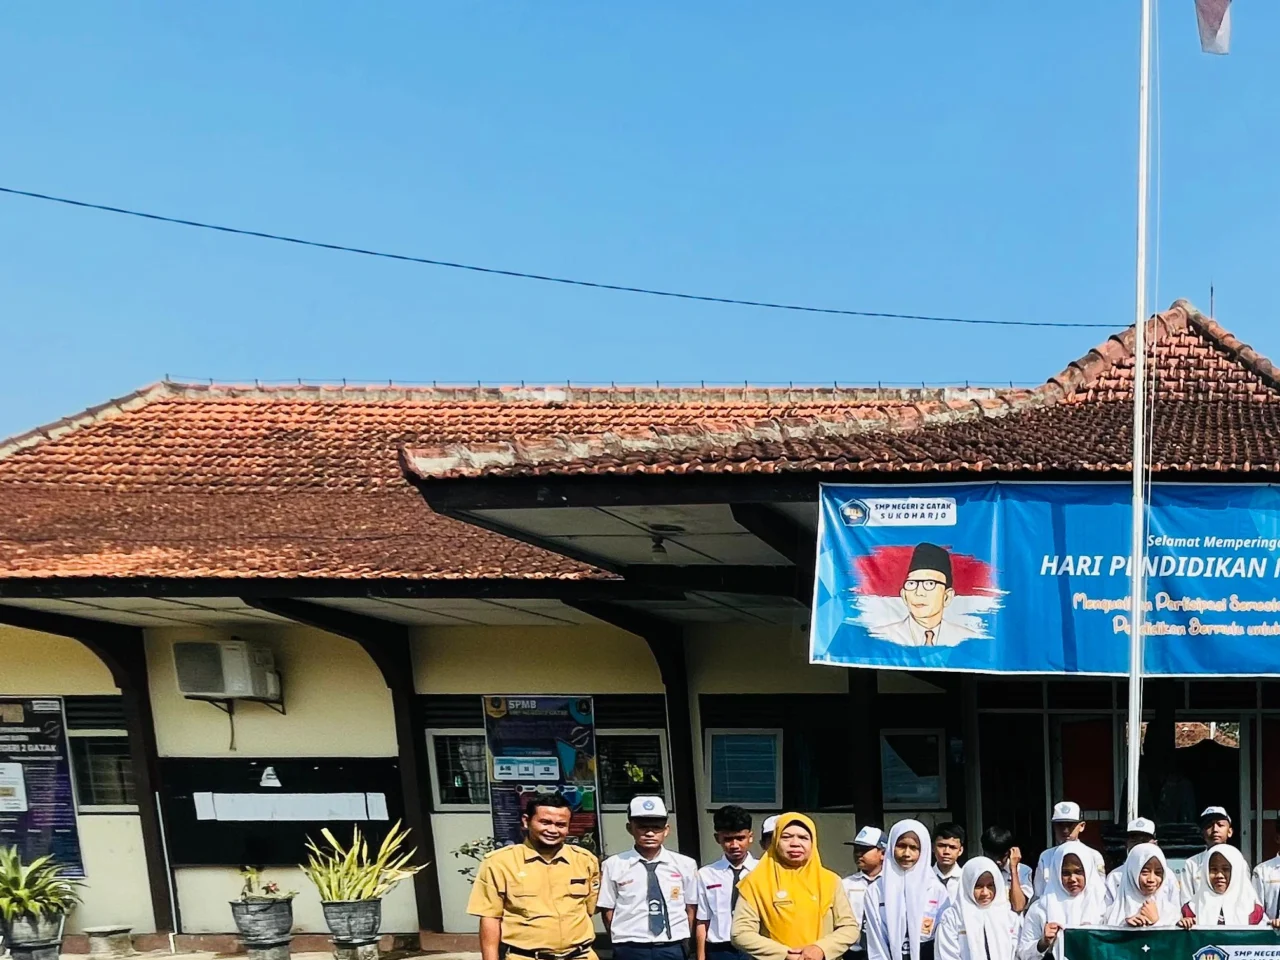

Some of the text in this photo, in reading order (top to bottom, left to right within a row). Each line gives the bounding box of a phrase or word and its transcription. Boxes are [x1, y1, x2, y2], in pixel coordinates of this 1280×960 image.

[880, 512, 947, 520] SUKOHARJO
[1147, 535, 1200, 548] Selamat
[1040, 555, 1103, 576] HARI
[1155, 592, 1227, 614] Partisipasi
[1113, 615, 1187, 636] Pedidikan
[1188, 617, 1245, 636] Bermutu
[509, 700, 537, 709] SPMB
[28, 744, 57, 752] GATAK
